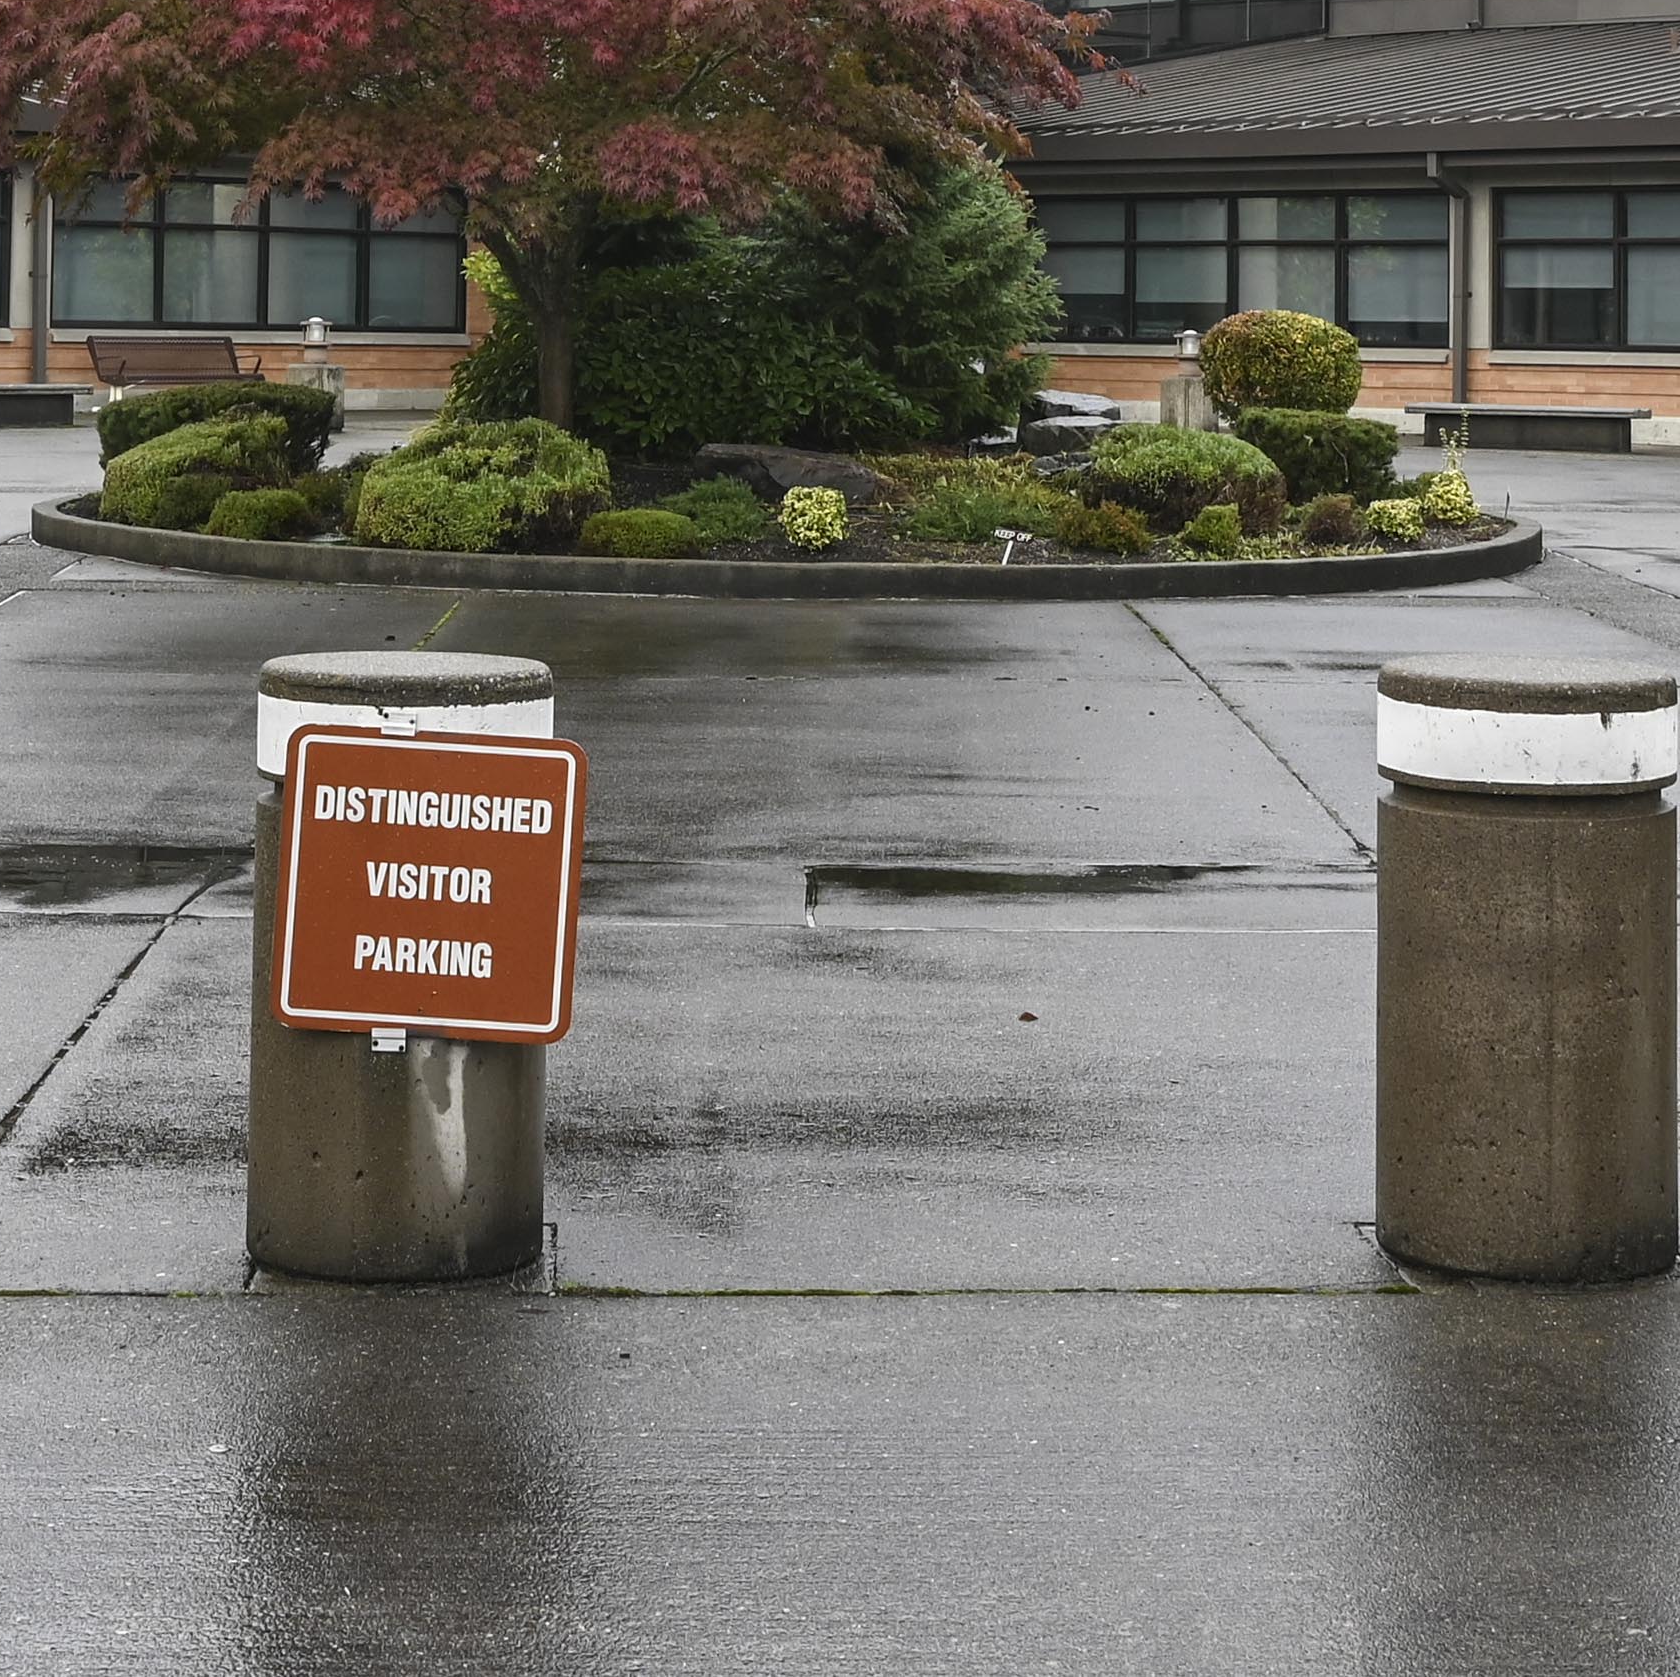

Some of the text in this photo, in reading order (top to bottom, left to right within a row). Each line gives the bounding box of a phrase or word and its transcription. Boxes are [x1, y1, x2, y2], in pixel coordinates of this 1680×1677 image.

[994, 529, 1032, 542] KEEP OFF
[314, 784, 553, 835] DISTINGUISHED
[366, 861, 492, 905] VISITOR
[353, 934, 493, 979] PARKING
